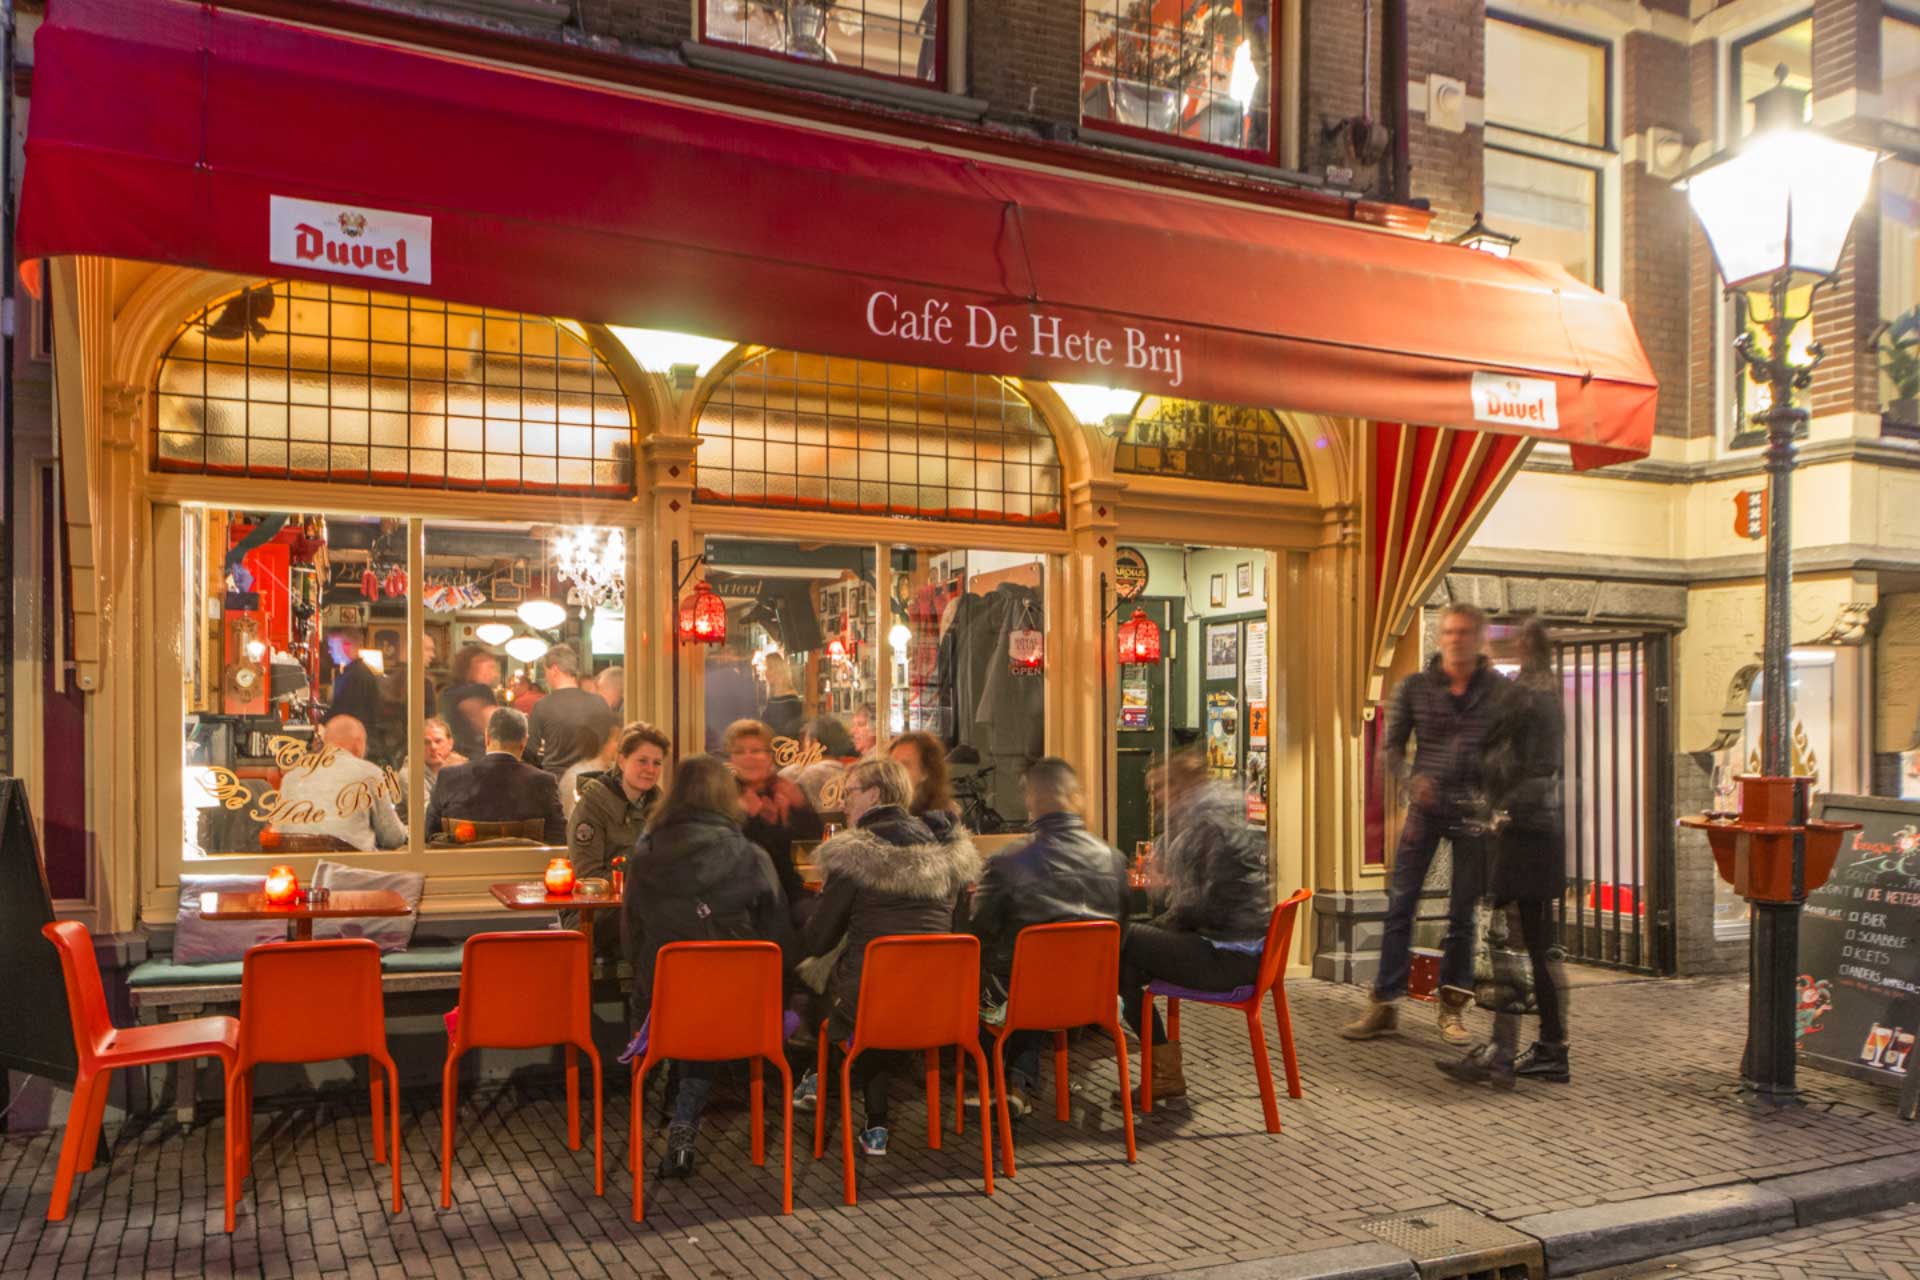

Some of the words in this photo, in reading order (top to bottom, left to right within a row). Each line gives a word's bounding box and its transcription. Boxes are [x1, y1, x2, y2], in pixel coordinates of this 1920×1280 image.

[294, 223, 409, 274] Duvel
[866, 291, 953, 345] Café
[964, 304, 1019, 353] De
[1029, 313, 1113, 366] Hete
[1123, 327, 1184, 387] Brij
[1486, 392, 1545, 422] Duvel
[1011, 667, 1041, 677] OPEN
[1860, 911, 1888, 929] BIER
[1856, 930, 1908, 949] SCRABBLE
